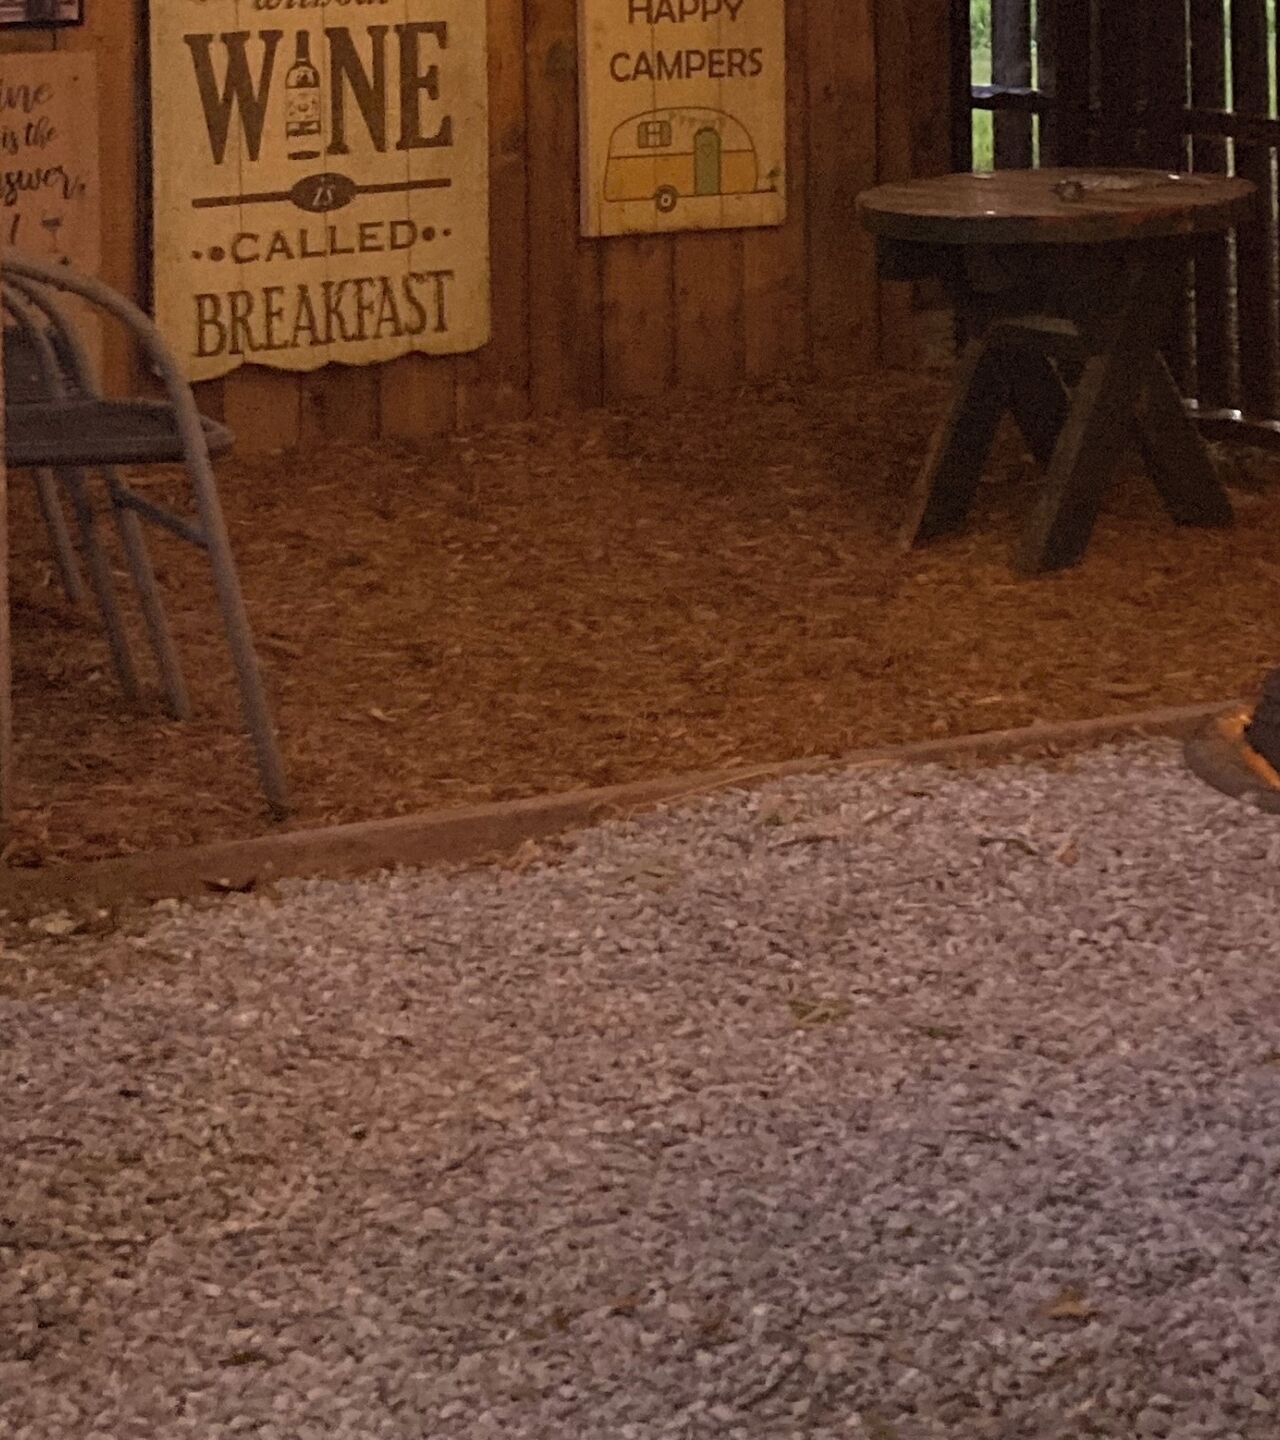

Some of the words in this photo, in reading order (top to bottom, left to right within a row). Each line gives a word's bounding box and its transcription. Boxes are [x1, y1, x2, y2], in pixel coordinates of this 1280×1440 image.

[609, 47, 764, 83] CAMPERS
[230, 219, 417, 264] CALLED
[193, 269, 454, 358] BREAKFAST
